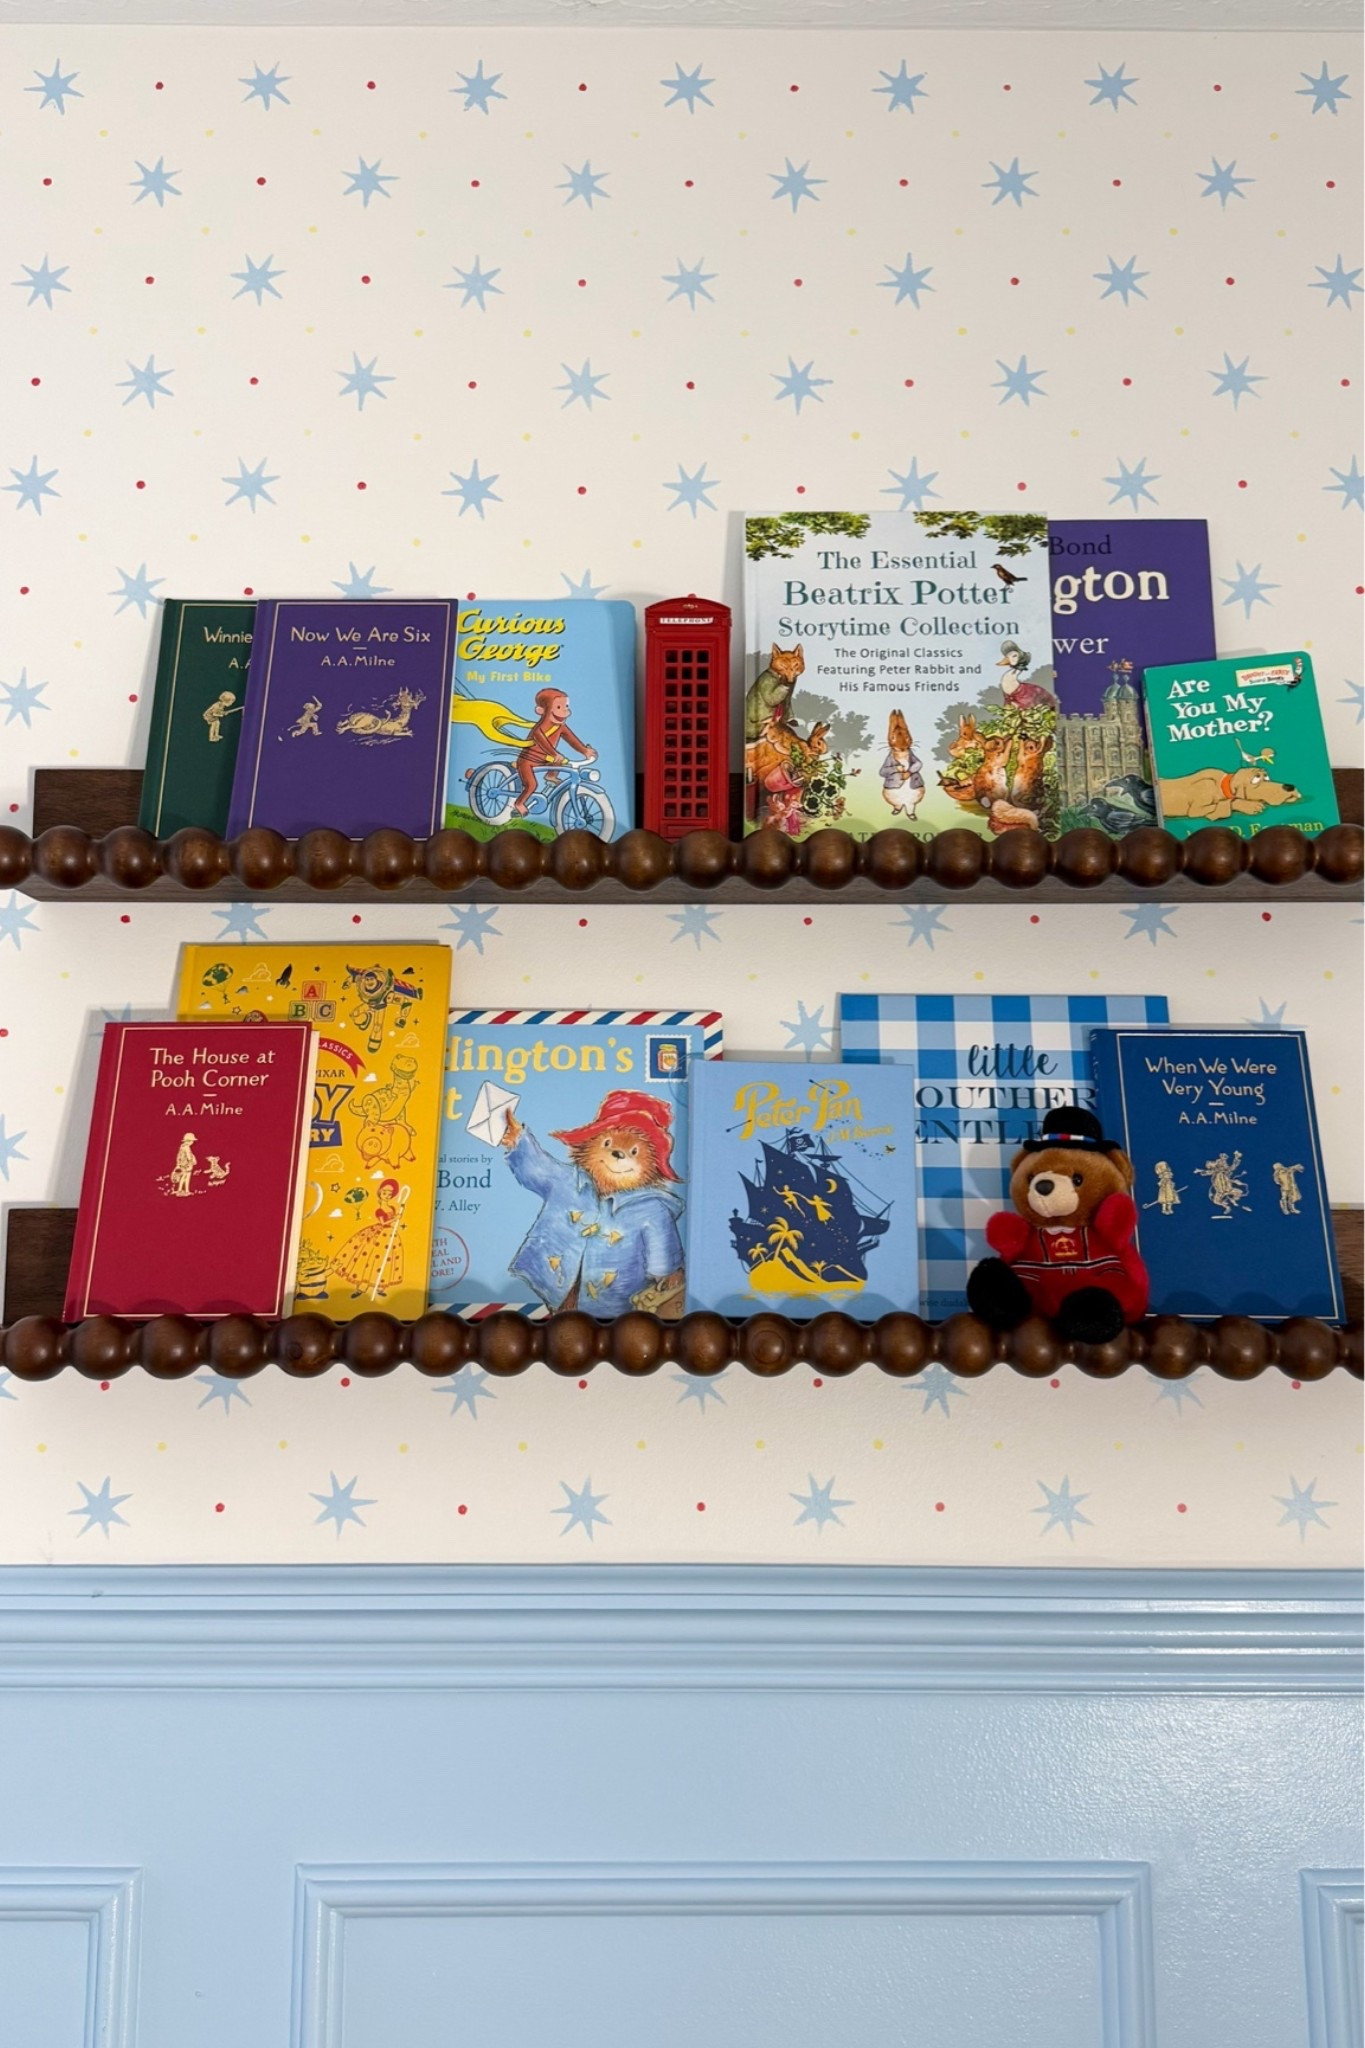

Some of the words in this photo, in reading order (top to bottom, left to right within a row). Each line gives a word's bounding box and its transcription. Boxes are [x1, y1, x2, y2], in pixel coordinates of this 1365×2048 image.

[1049, 534, 1112, 555] Bond
[817, 551, 861, 570] The
[870, 550, 978, 570] Essential
[783, 580, 904, 606] Beatrix
[910, 580, 1014, 606] Potter
[457, 608, 565, 635] Curious
[778, 616, 891, 641] Storytime
[900, 616, 1020, 636] Collection
[204, 626, 253, 643] Winnie
[291, 627, 330, 643] Now
[336, 627, 361, 643] We
[367, 627, 399, 643] Are
[403, 626, 431, 643] Six
[458, 635, 560, 668] George
[834, 648, 857, 658] The
[860, 648, 910, 661] Original
[914, 647, 963, 658] Classics
[1052, 637, 1109, 654] wer
[466, 671, 485, 684] My
[490, 671, 518, 682] First
[523, 671, 552, 682] Bike
[817, 664, 876, 677] Featuring
[880, 664, 910, 674] Peter
[915, 664, 955, 674] Rabbit
[959, 664, 982, 674] and
[839, 682, 859, 692] His
[863, 682, 910, 692] Famous
[915, 681, 960, 692] Friends
[1166, 680, 1210, 700] Are
[1170, 702, 1217, 719] You
[1222, 692, 1267, 714] My
[1166, 711, 1274, 742] Mother?
[304, 985, 318, 998] A
[150, 1048, 185, 1065] The
[193, 1047, 249, 1065] House
[257, 1050, 276, 1064] at
[319, 1041, 353, 1060] ASSICS
[968, 1043, 1058, 1078] little
[1145, 1056, 1197, 1075] When
[1199, 1058, 1228, 1075] We
[1231, 1058, 1277, 1075] Were
[151, 1070, 195, 1088] Pooh
[202, 1069, 269, 1087] Corner
[1162, 1078, 1203, 1104] Very
[1208, 1078, 1266, 1105] Young
[733, 1080, 811, 1140] Peter
[807, 1079, 863, 1131] Pan
[449, 1154, 478, 1163] stories
[481, 1154, 493, 1166] by
[436, 1168, 491, 1188] Bond
[448, 1199, 481, 1214] Alley
[440, 1256, 462, 1266] AND
